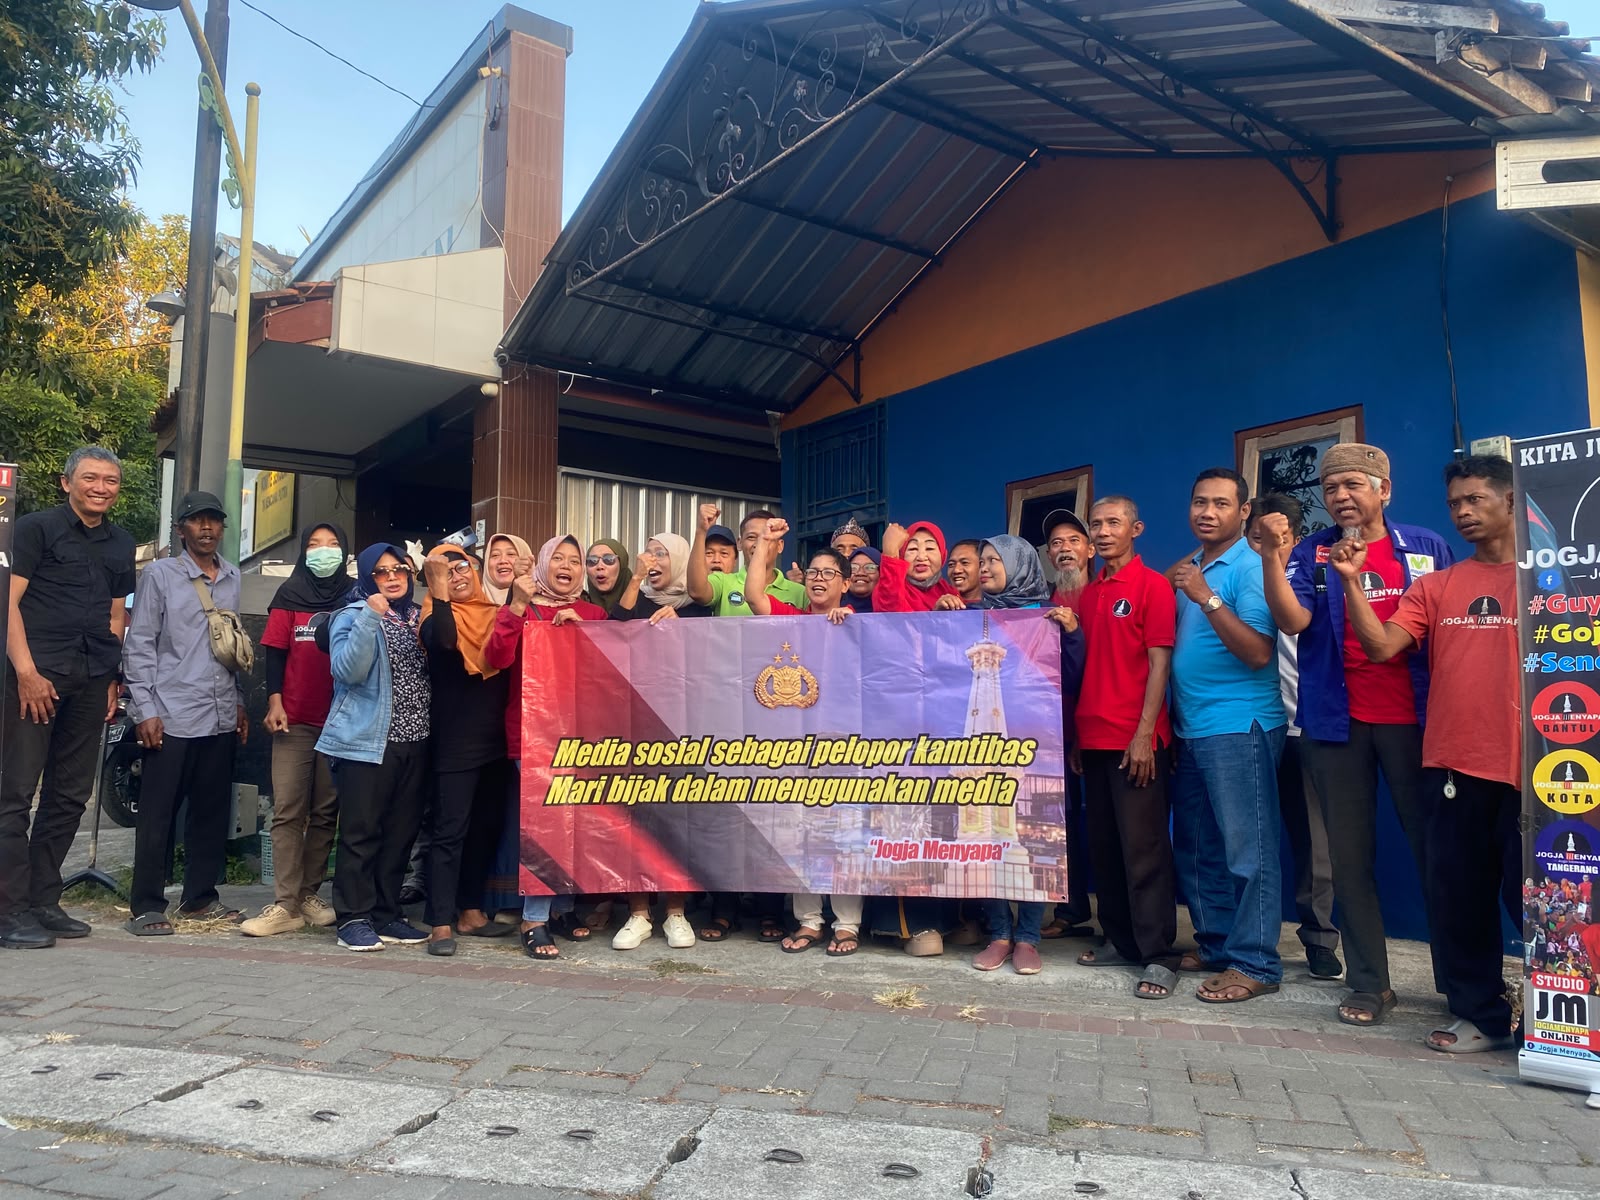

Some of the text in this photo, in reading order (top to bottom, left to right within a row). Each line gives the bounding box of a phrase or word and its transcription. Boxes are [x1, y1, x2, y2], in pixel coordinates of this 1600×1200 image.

[1520, 442, 1577, 467] KITA
[1517, 544, 1600, 570] JOGJ
[1440, 616, 1475, 626] JOGJA
[1543, 724, 1595, 732] BANTUL
[552, 733, 1038, 769] Media sosial sebagai pelopor kamtibas
[544, 772, 1020, 807] Mari bijak dalam menggunakan media
[1547, 793, 1594, 804] KOTA
[1535, 851, 1600, 861] JOGJA MENYA
[1547, 862, 1598, 875] TANGERANG
[1536, 974, 1584, 991] STUDIO
[1541, 1031, 1581, 1044] ONLINE
[1539, 1045, 1592, 1059] Jogja Menyapa
